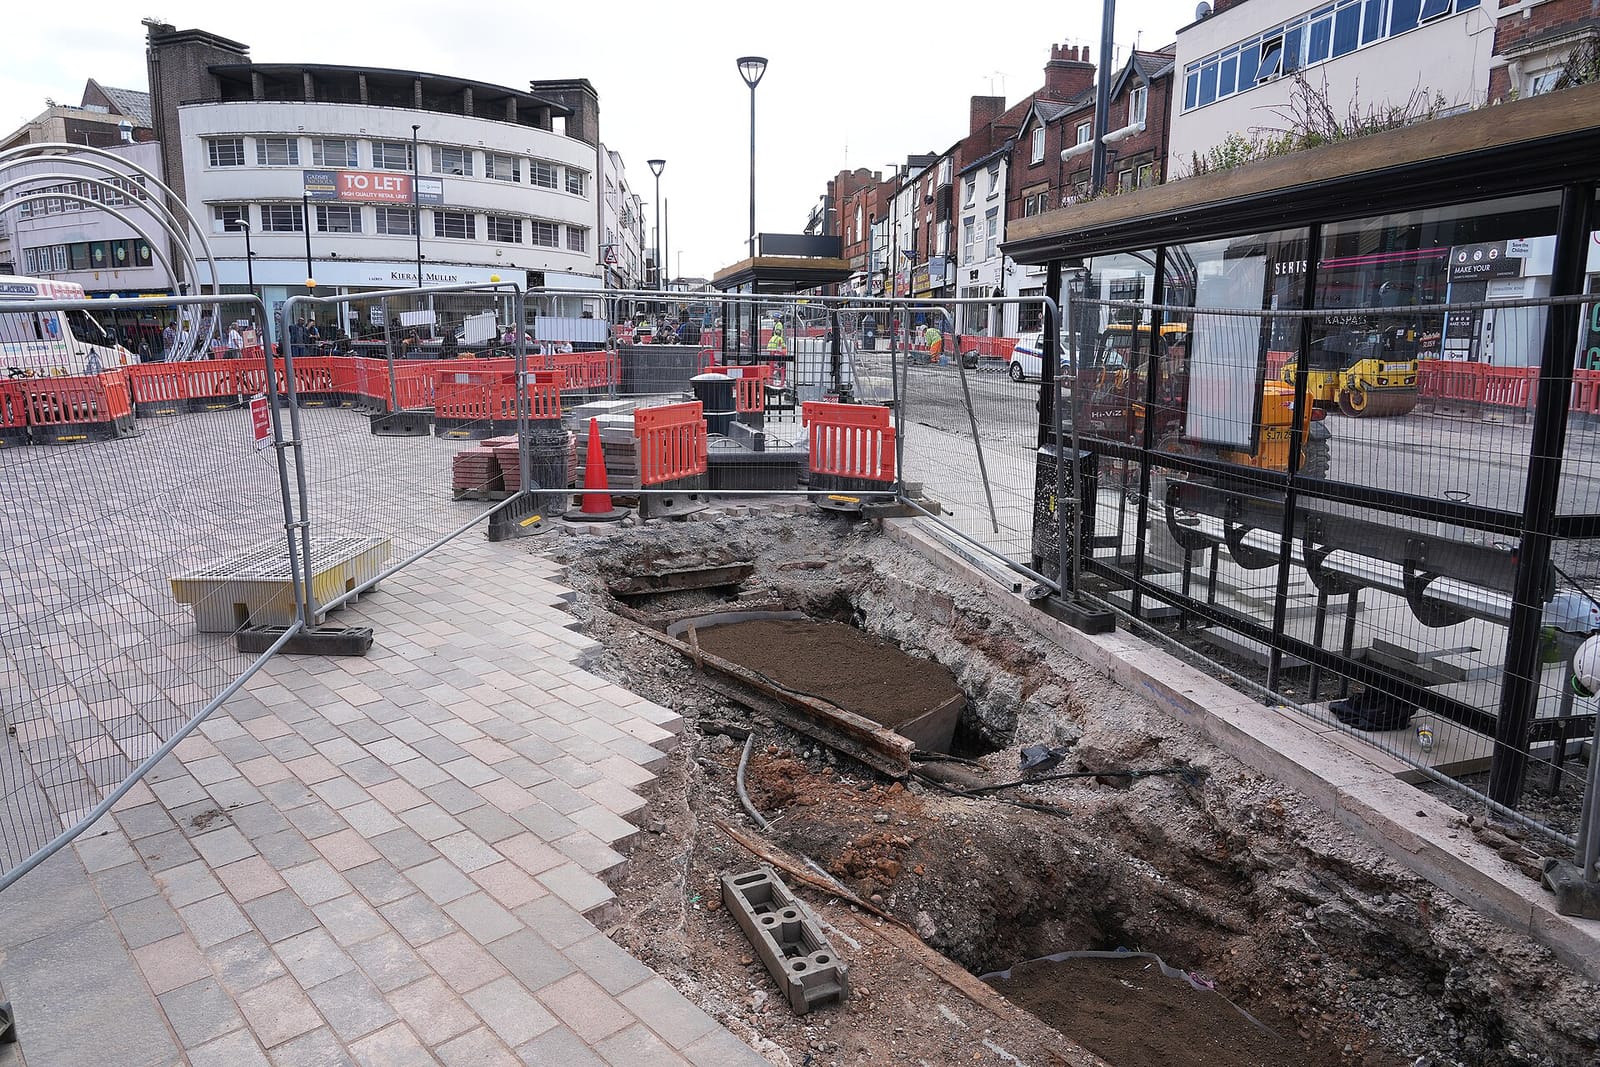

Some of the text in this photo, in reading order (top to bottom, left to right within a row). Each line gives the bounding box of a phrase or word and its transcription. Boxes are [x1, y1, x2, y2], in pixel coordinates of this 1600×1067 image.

[344, 175, 369, 189] TO
[374, 176, 404, 191] LET
[1454, 264, 1491, 274] MAKE YOUR
[426, 272, 457, 282] MULLIN
